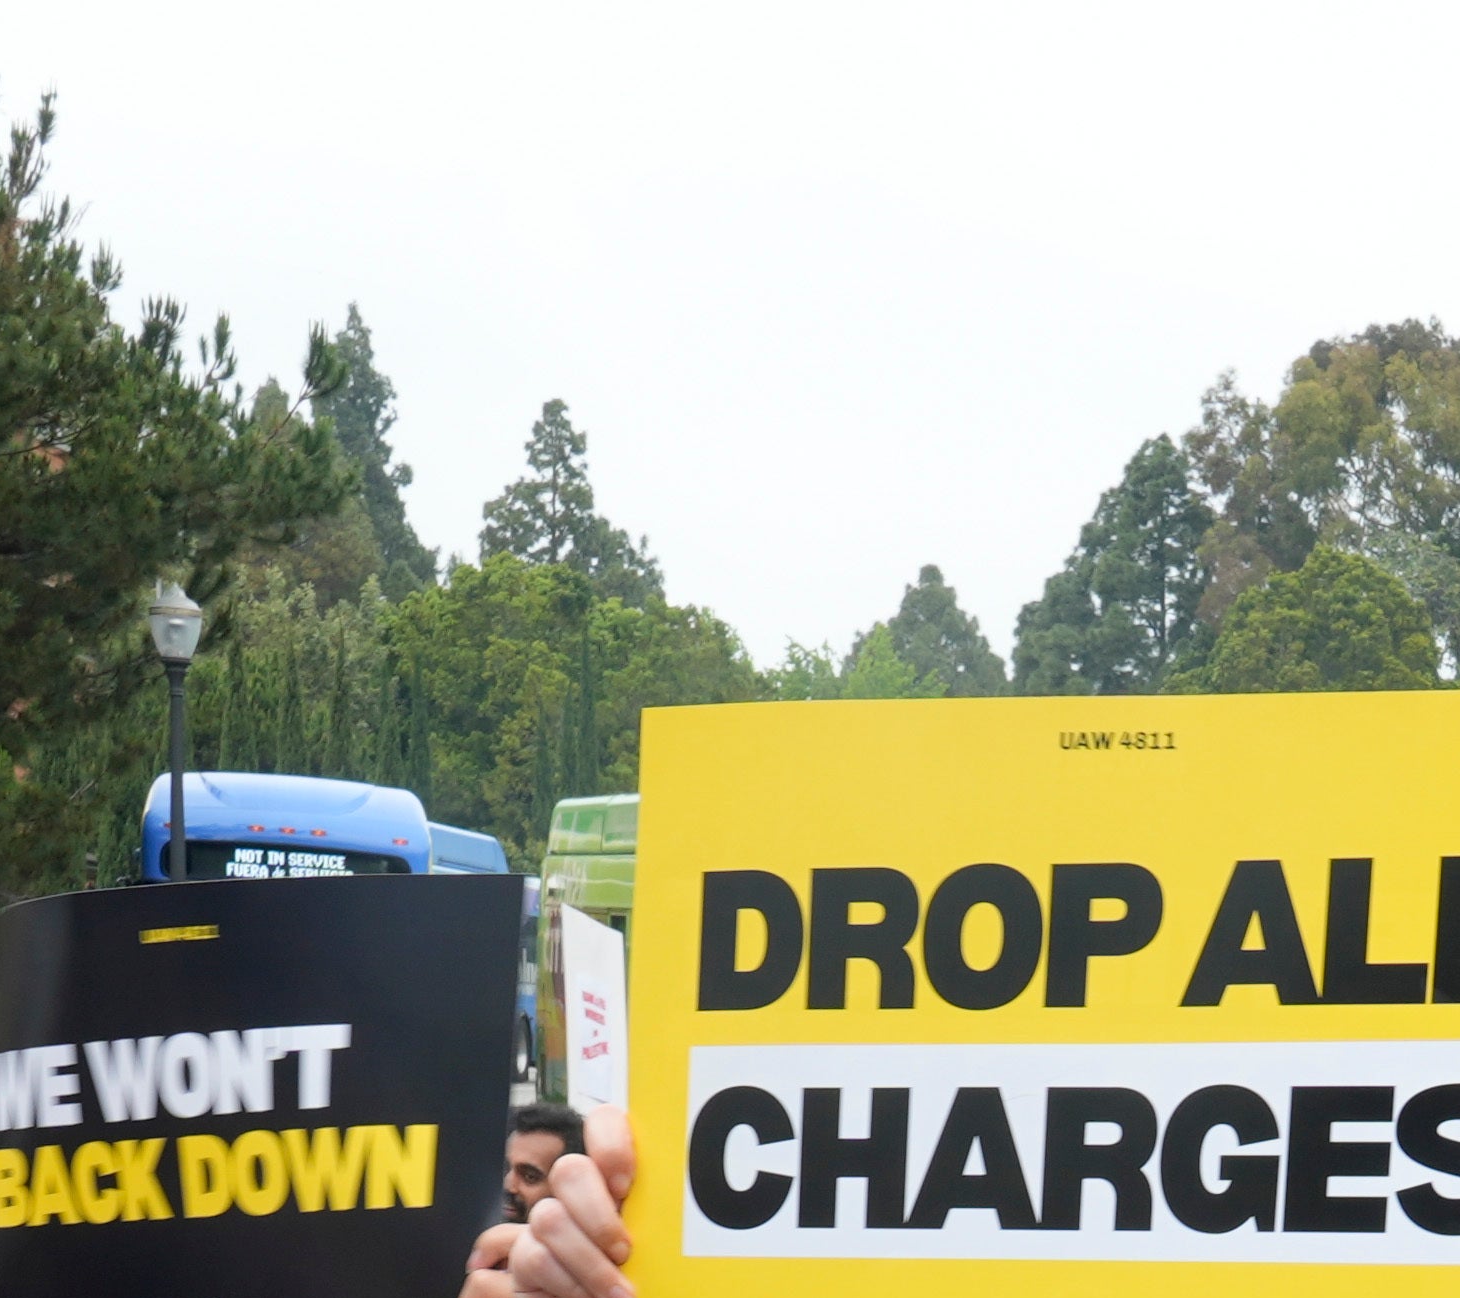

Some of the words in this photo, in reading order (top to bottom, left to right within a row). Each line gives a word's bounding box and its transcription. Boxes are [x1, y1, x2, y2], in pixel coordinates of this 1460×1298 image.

[1059, 731, 1115, 750] UAW
[1118, 731, 1177, 750] 4811
[226, 862, 268, 877] FUERA
[234, 848, 263, 863] NOT
[267, 851, 285, 866] IN
[288, 853, 346, 870] SERVICE
[696, 861, 1164, 1011] DROP
[83, 1023, 352, 1123] WON'T
[176, 1124, 439, 1219] DOWN
